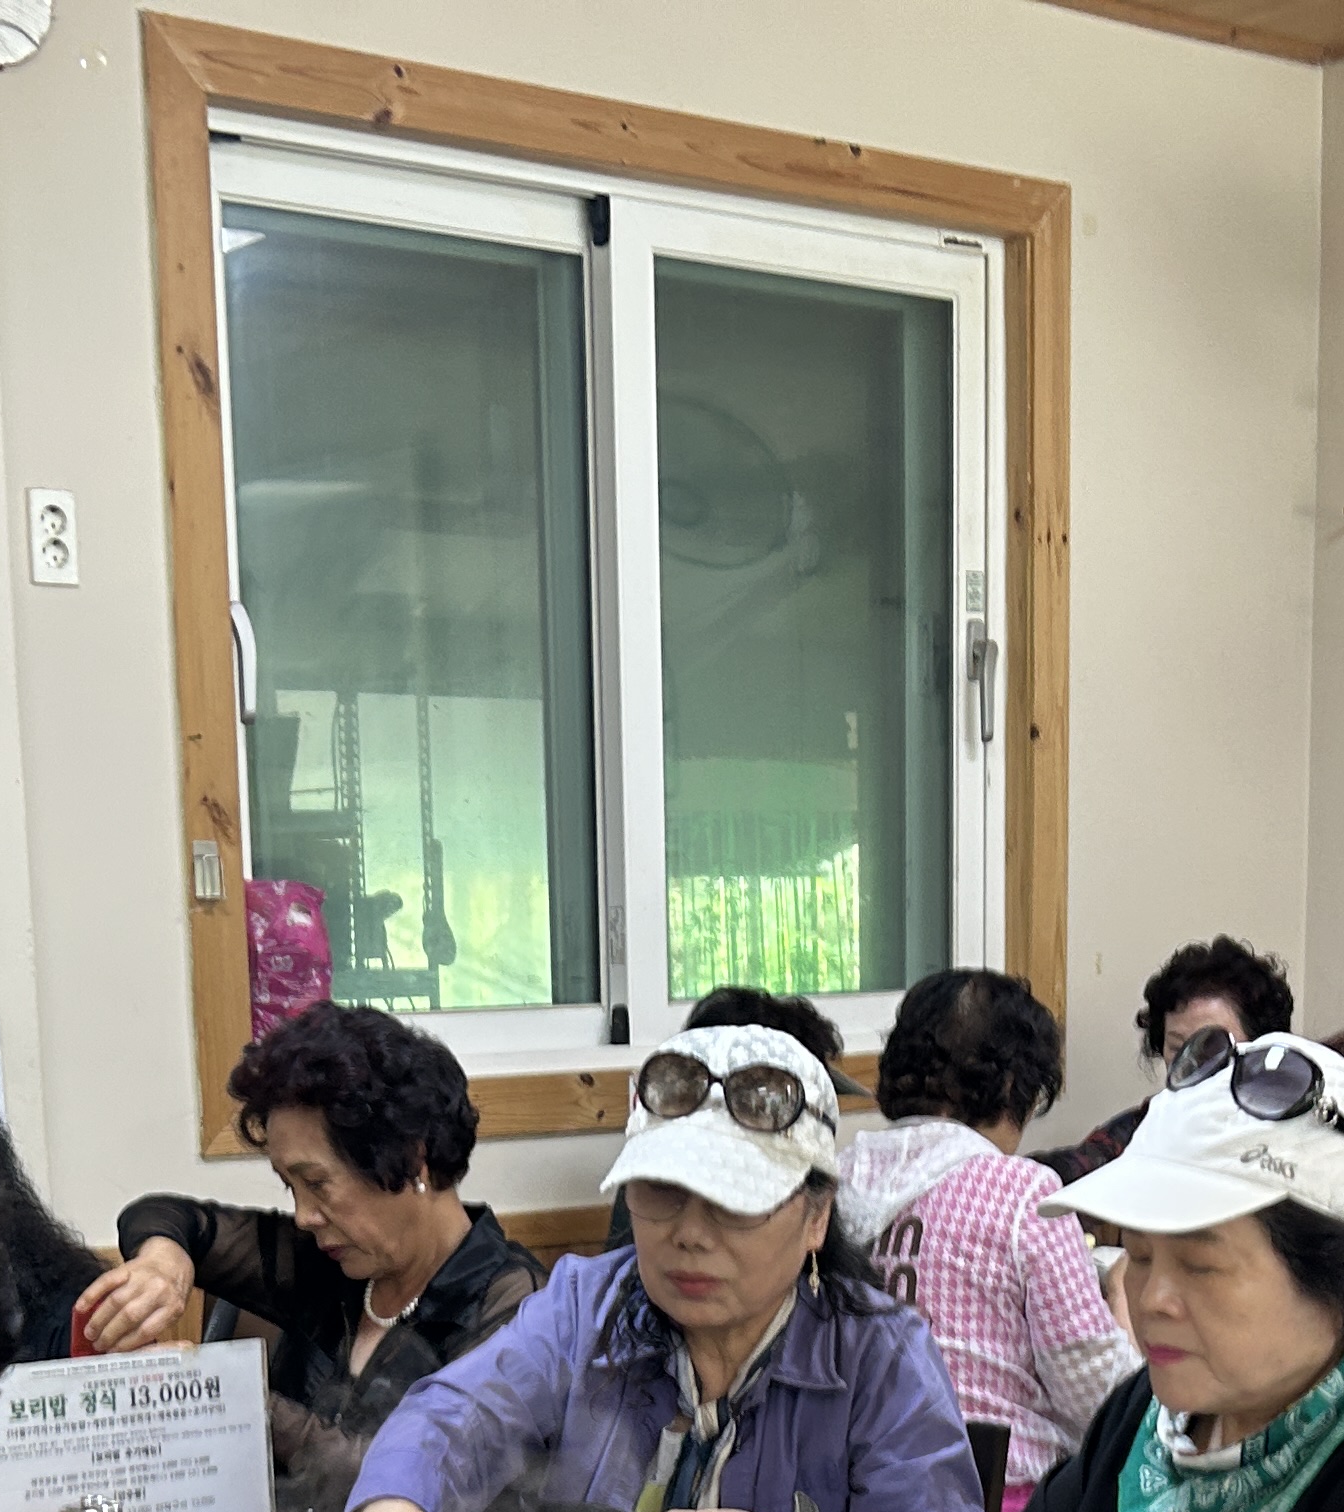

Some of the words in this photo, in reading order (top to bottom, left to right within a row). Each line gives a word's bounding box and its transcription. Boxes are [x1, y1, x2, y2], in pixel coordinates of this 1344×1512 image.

[9, 1393, 67, 1423] 보리밥
[80, 1388, 116, 1414] 정식
[130, 1376, 220, 1408] 13,000원
